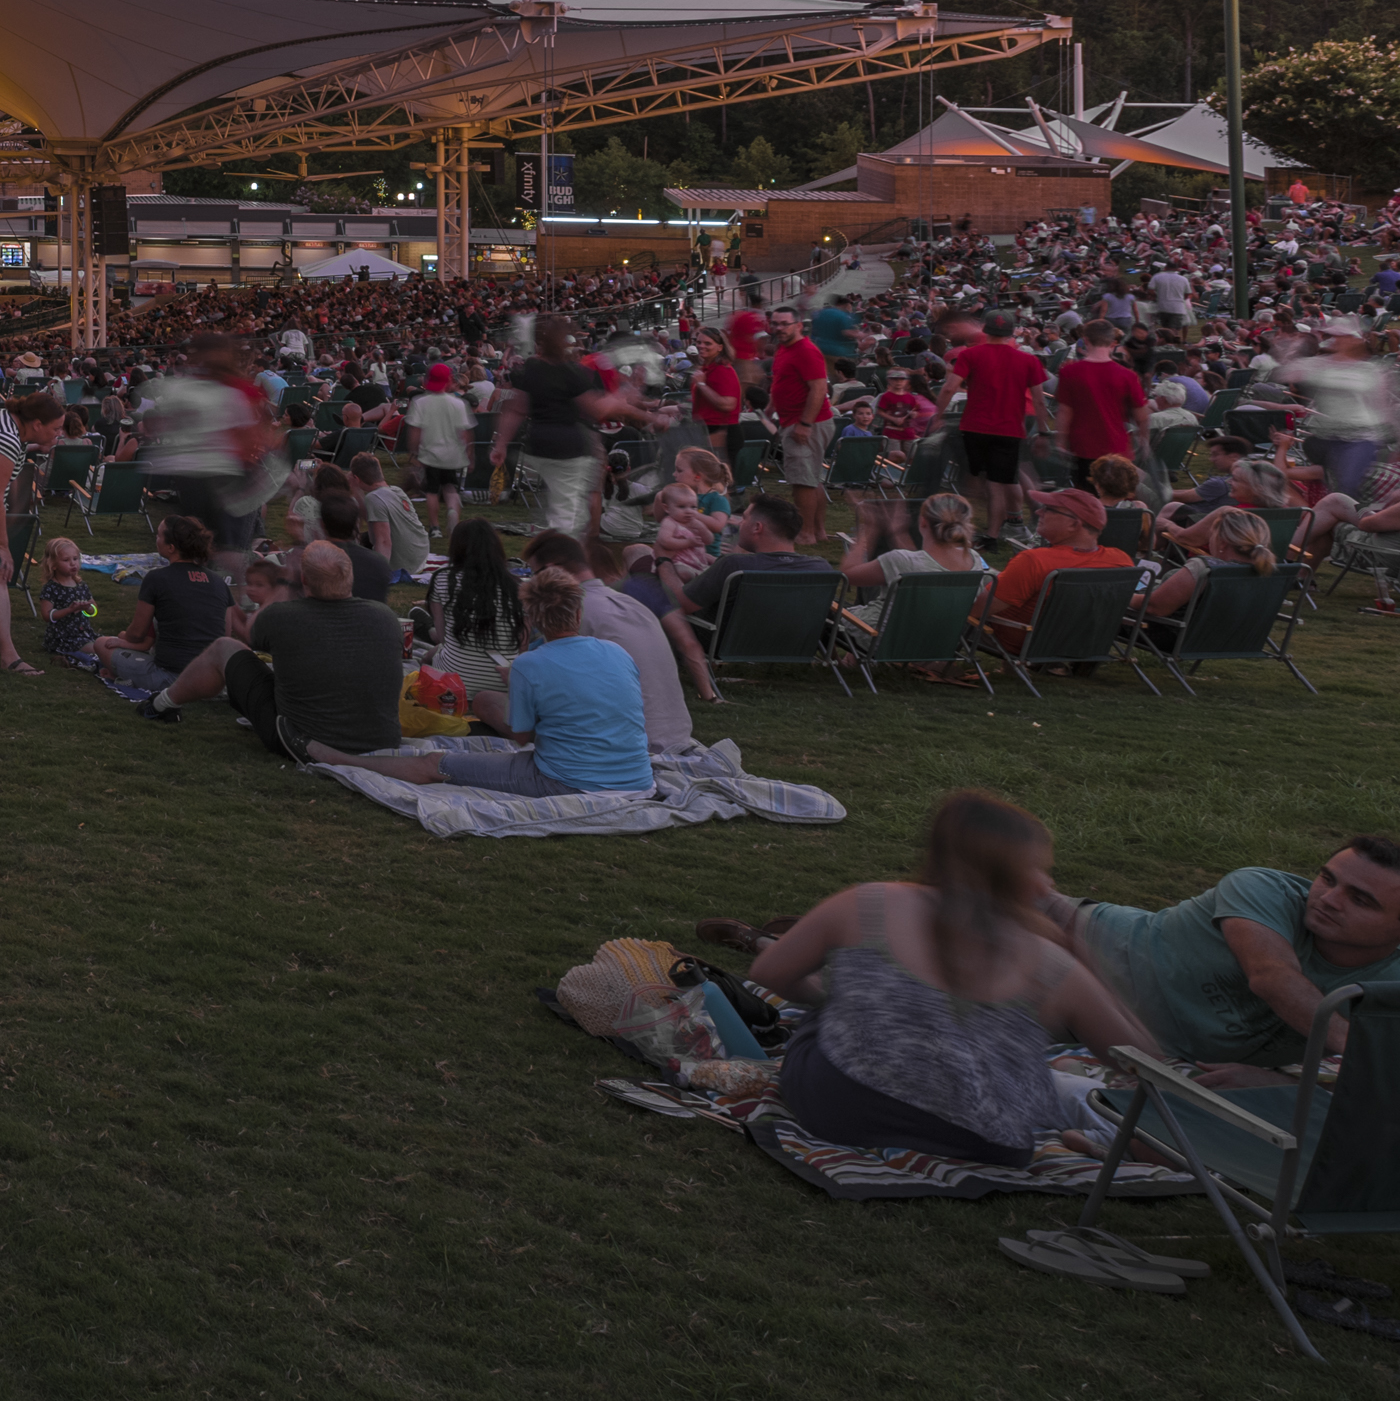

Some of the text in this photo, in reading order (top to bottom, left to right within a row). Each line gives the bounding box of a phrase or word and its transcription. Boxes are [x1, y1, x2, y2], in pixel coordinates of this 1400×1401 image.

[521, 161, 537, 203] xfinity
[549, 185, 573, 196] BUD
[187, 570, 210, 583] USA
[1200, 982, 1234, 1015] GET
